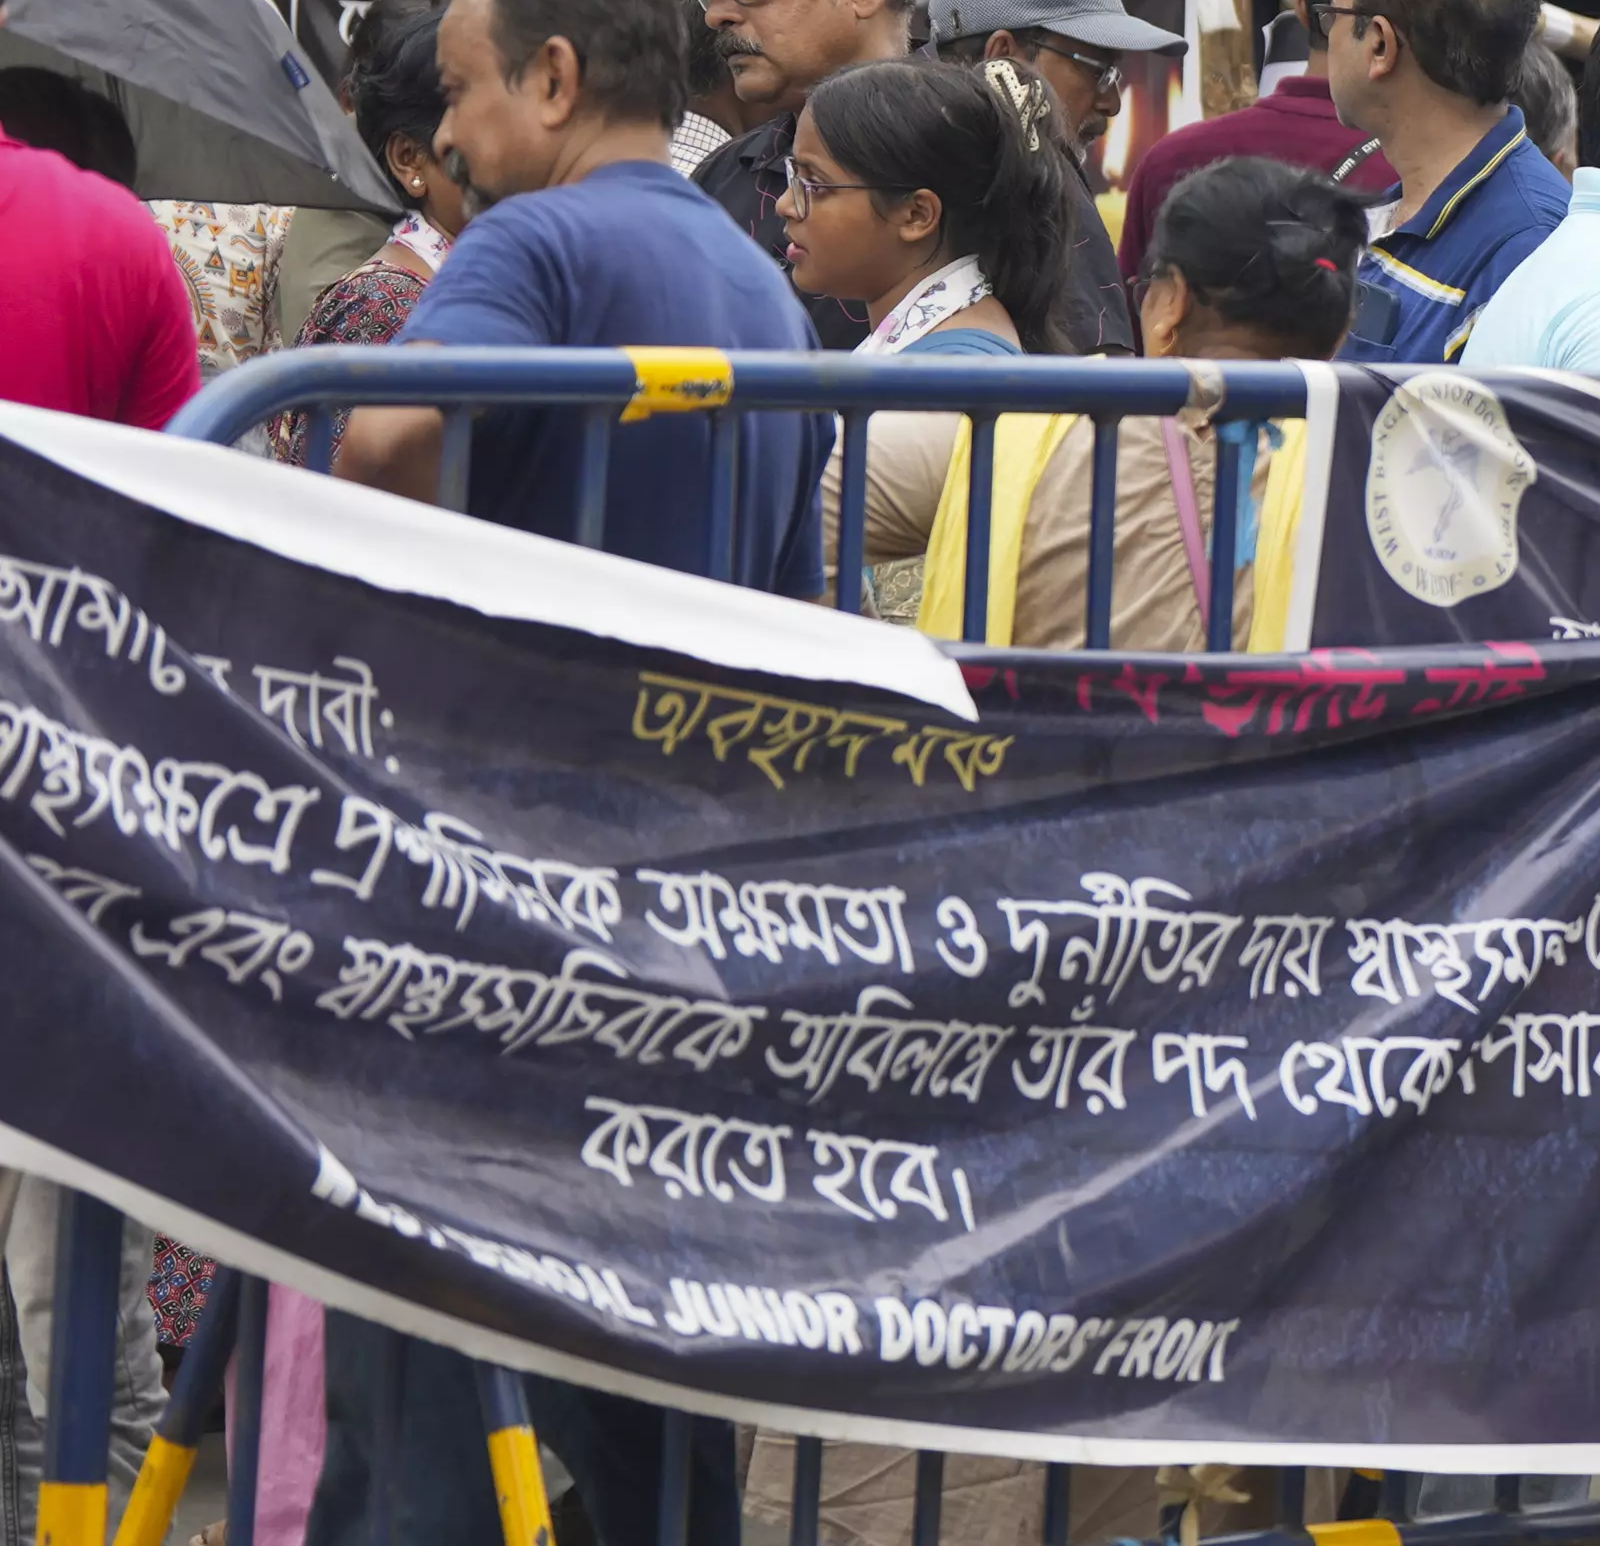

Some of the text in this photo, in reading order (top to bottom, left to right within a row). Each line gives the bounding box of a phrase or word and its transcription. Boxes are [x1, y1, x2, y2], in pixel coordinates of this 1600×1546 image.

[635, 867, 916, 974] অক্ষমতা
[935, 896, 990, 980] ও
[996, 870, 1245, 1009] দুর্নীতির
[1237, 912, 1336, 1001] দায়
[130, 906, 315, 1003] এবং
[764, 983, 1017, 1106] অবিলম্বে
[1011, 993, 1137, 1117] তাঁর
[1151, 1032, 1258, 1122] পদ
[1279, 1035, 1464, 1118] থেকে
[581, 1095, 793, 1203] করতে
[663, 1274, 863, 1357] JUNIOR
